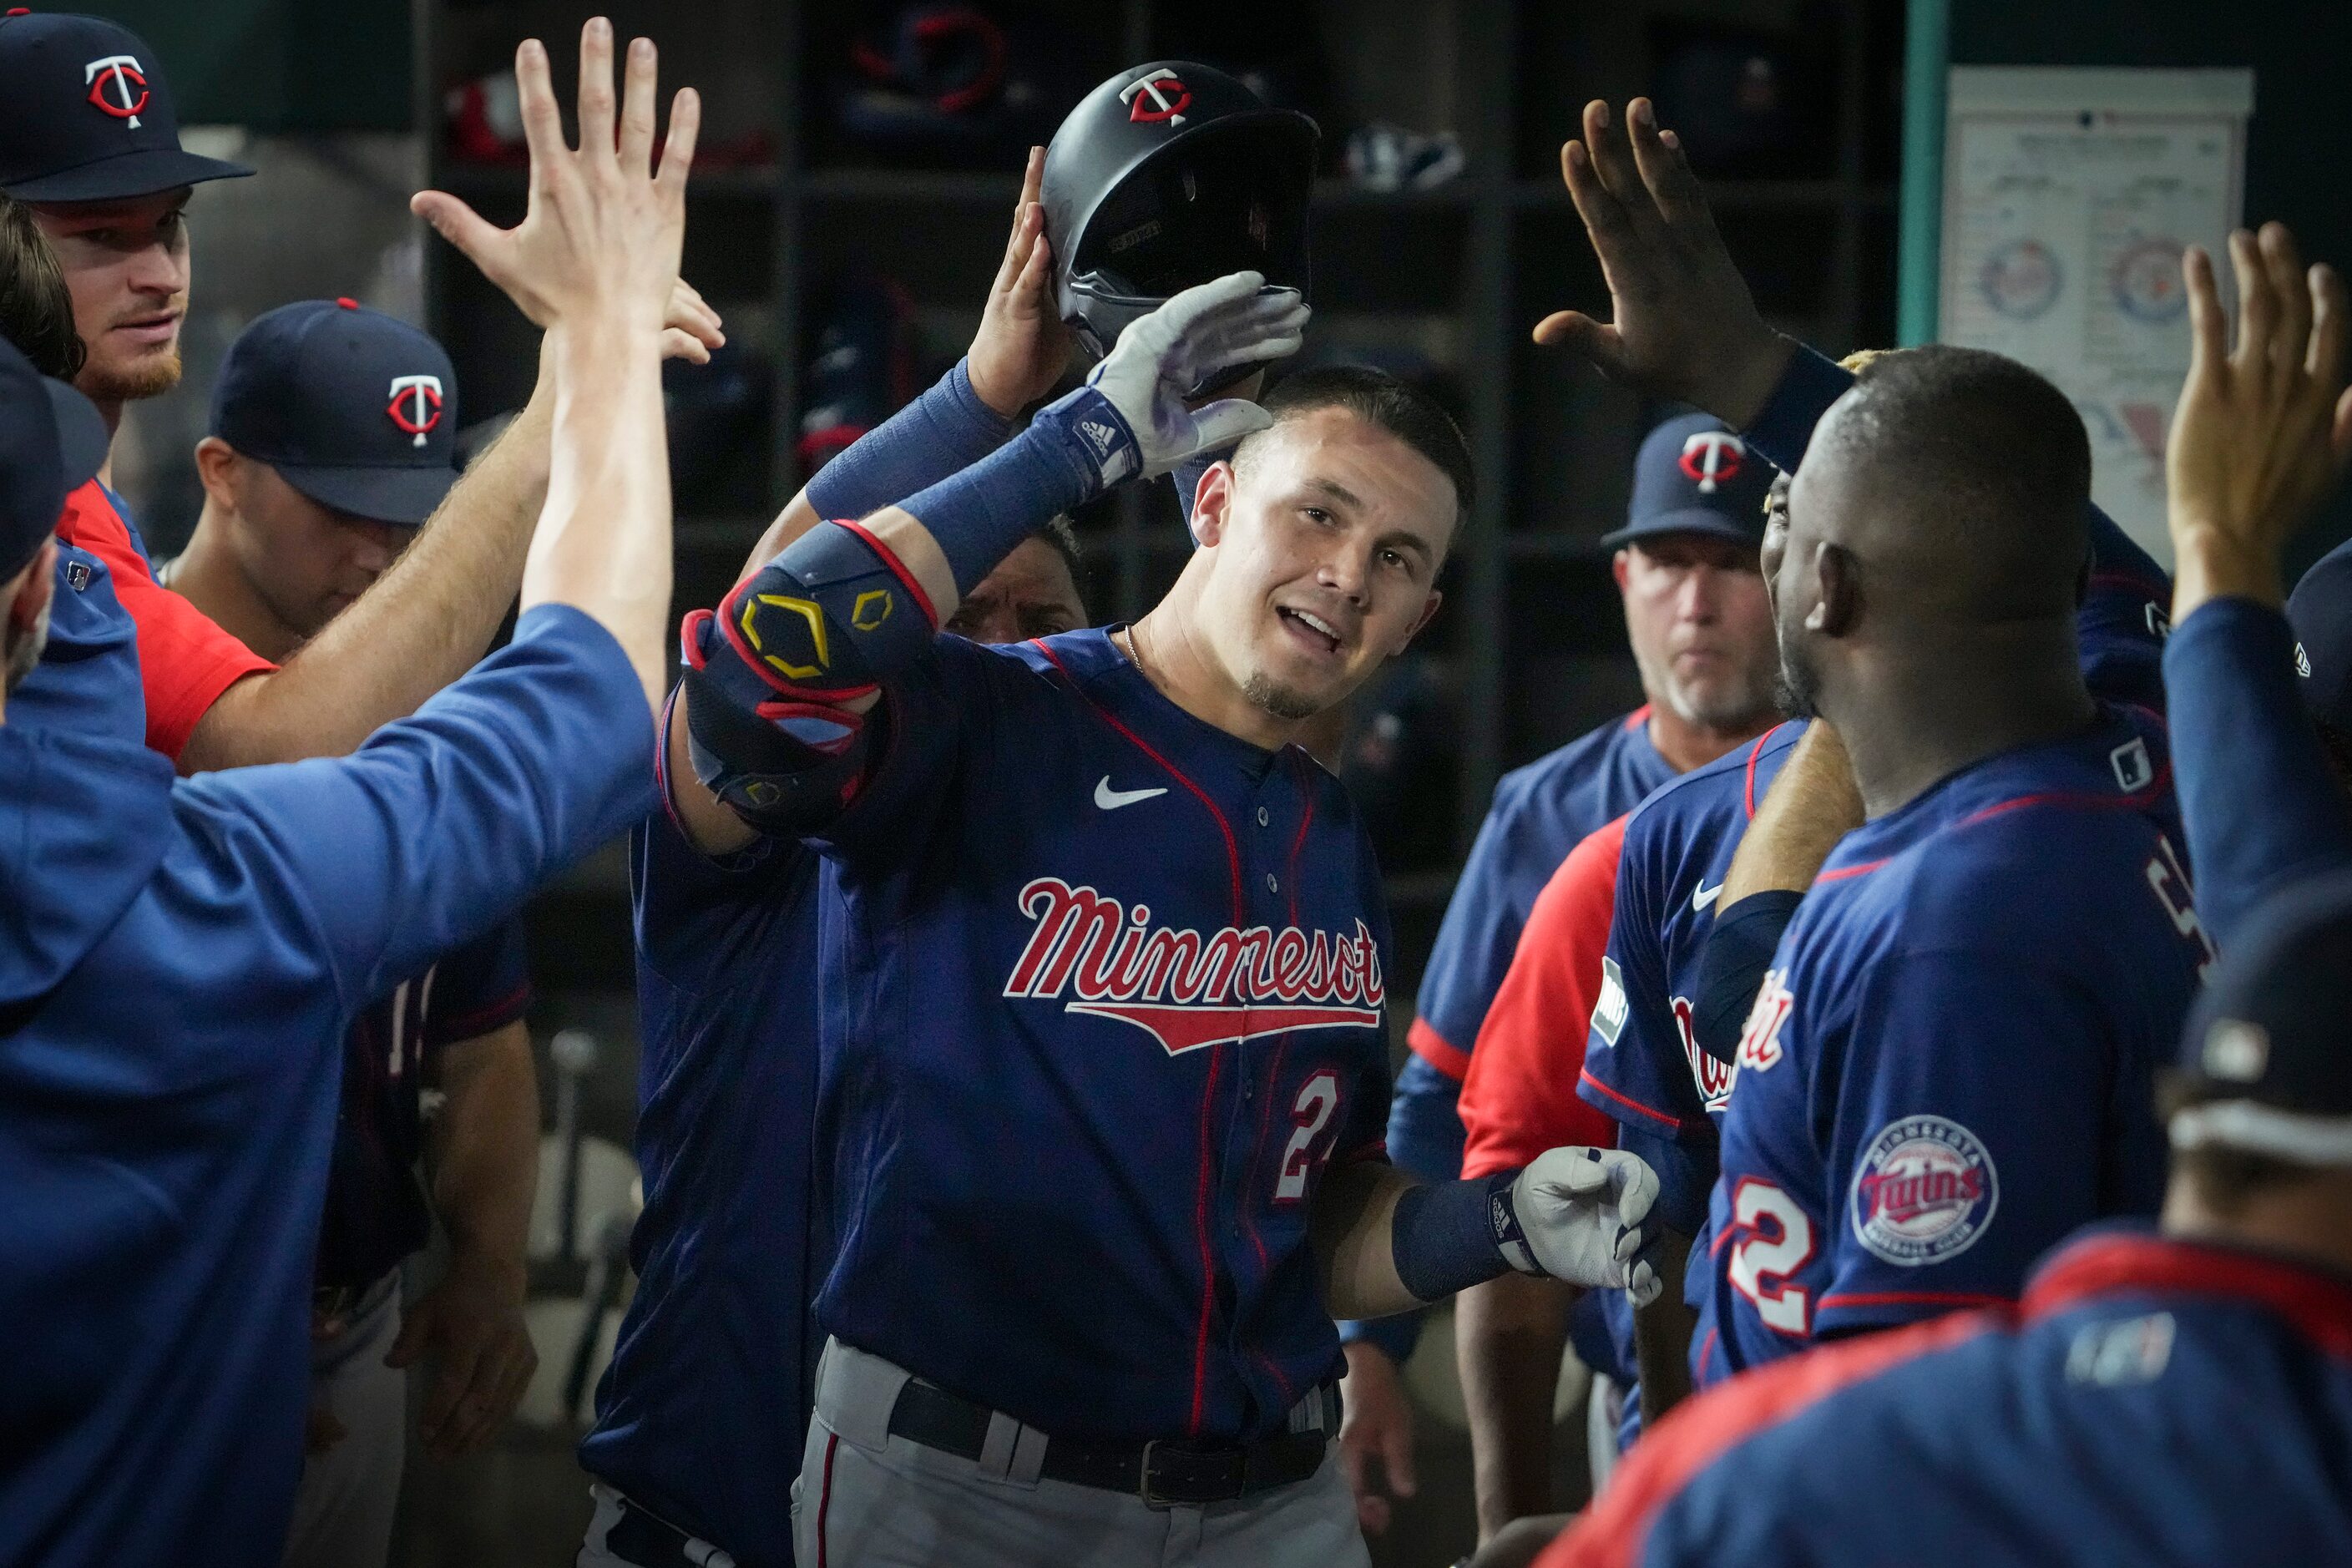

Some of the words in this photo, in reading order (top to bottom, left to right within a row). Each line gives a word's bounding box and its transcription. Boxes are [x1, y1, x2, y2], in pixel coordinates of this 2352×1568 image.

[1081, 421, 1109, 458] adidas
[1002, 876, 1387, 1009] Minnesot
[1272, 1067, 1340, 1204] 2
[1493, 1197, 1505, 1238] adidas
[1859, 1161, 1983, 1222] Twins
